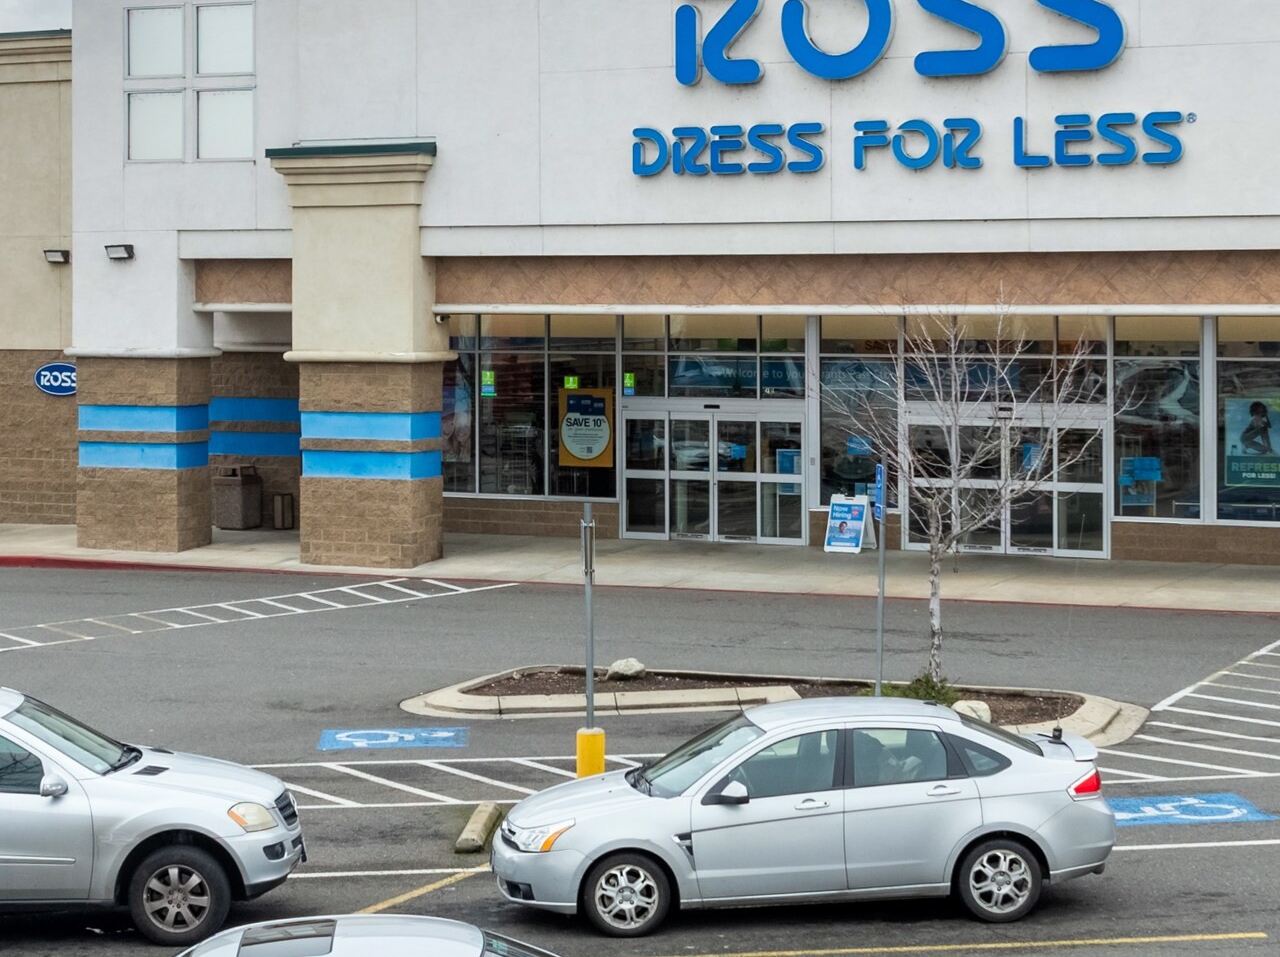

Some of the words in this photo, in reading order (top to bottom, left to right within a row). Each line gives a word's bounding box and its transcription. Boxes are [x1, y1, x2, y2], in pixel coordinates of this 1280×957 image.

[632, 122, 825, 175] DRESS
[853, 117, 984, 170] FOR
[772, 368, 783, 379] to
[566, 418, 590, 428] SAVE
[833, 512, 852, 520] Hiring
